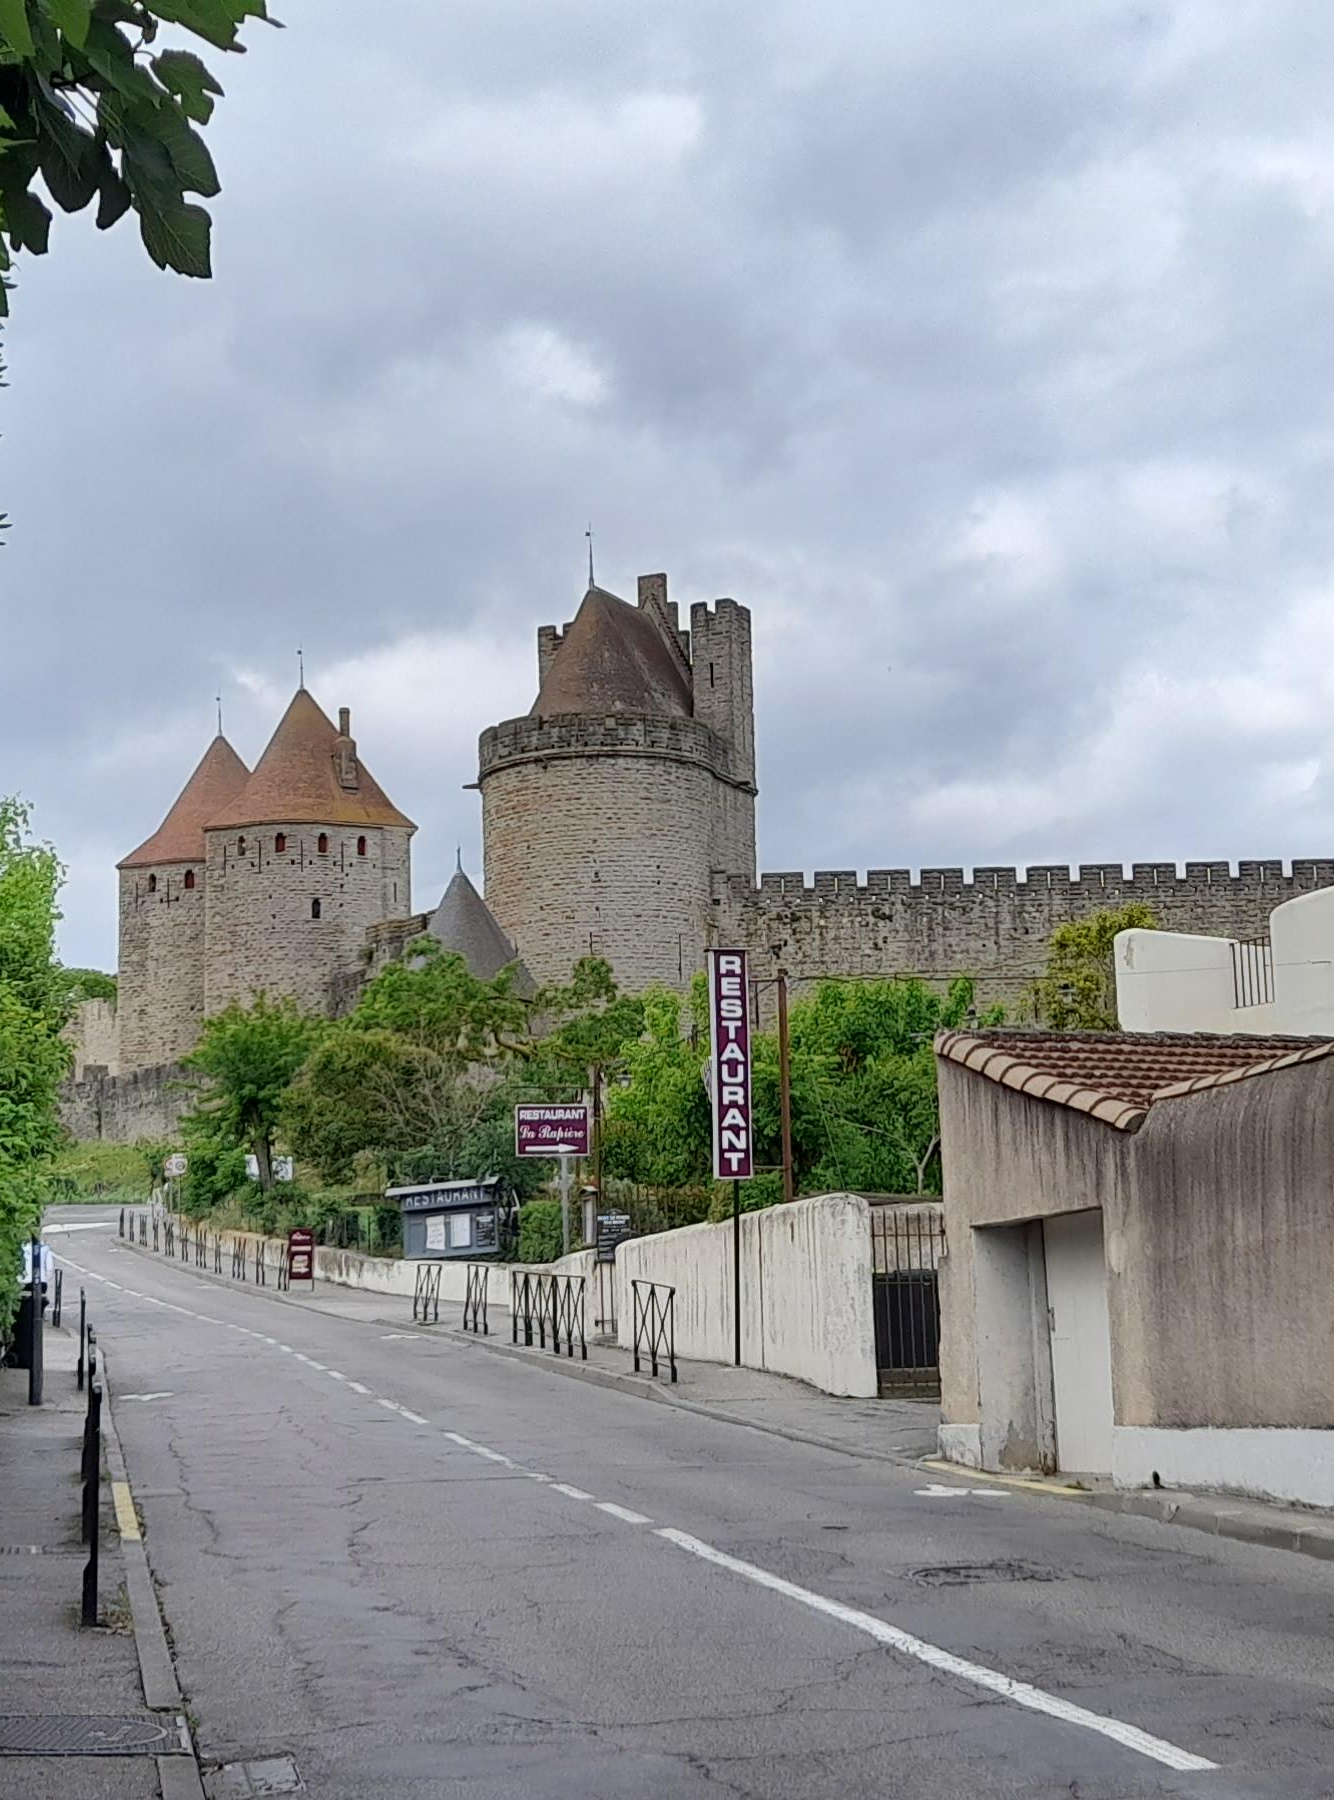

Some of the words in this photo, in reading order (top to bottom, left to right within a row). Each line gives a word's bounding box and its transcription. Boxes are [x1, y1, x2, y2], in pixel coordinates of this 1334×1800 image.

[719, 954, 747, 1172] RESTAURANT
[519, 1109, 585, 1120] RESTAURANT
[519, 1124, 536, 1139] La
[538, 1124, 585, 1142] Rapière
[405, 1186, 486, 1207] RESTAURANT
